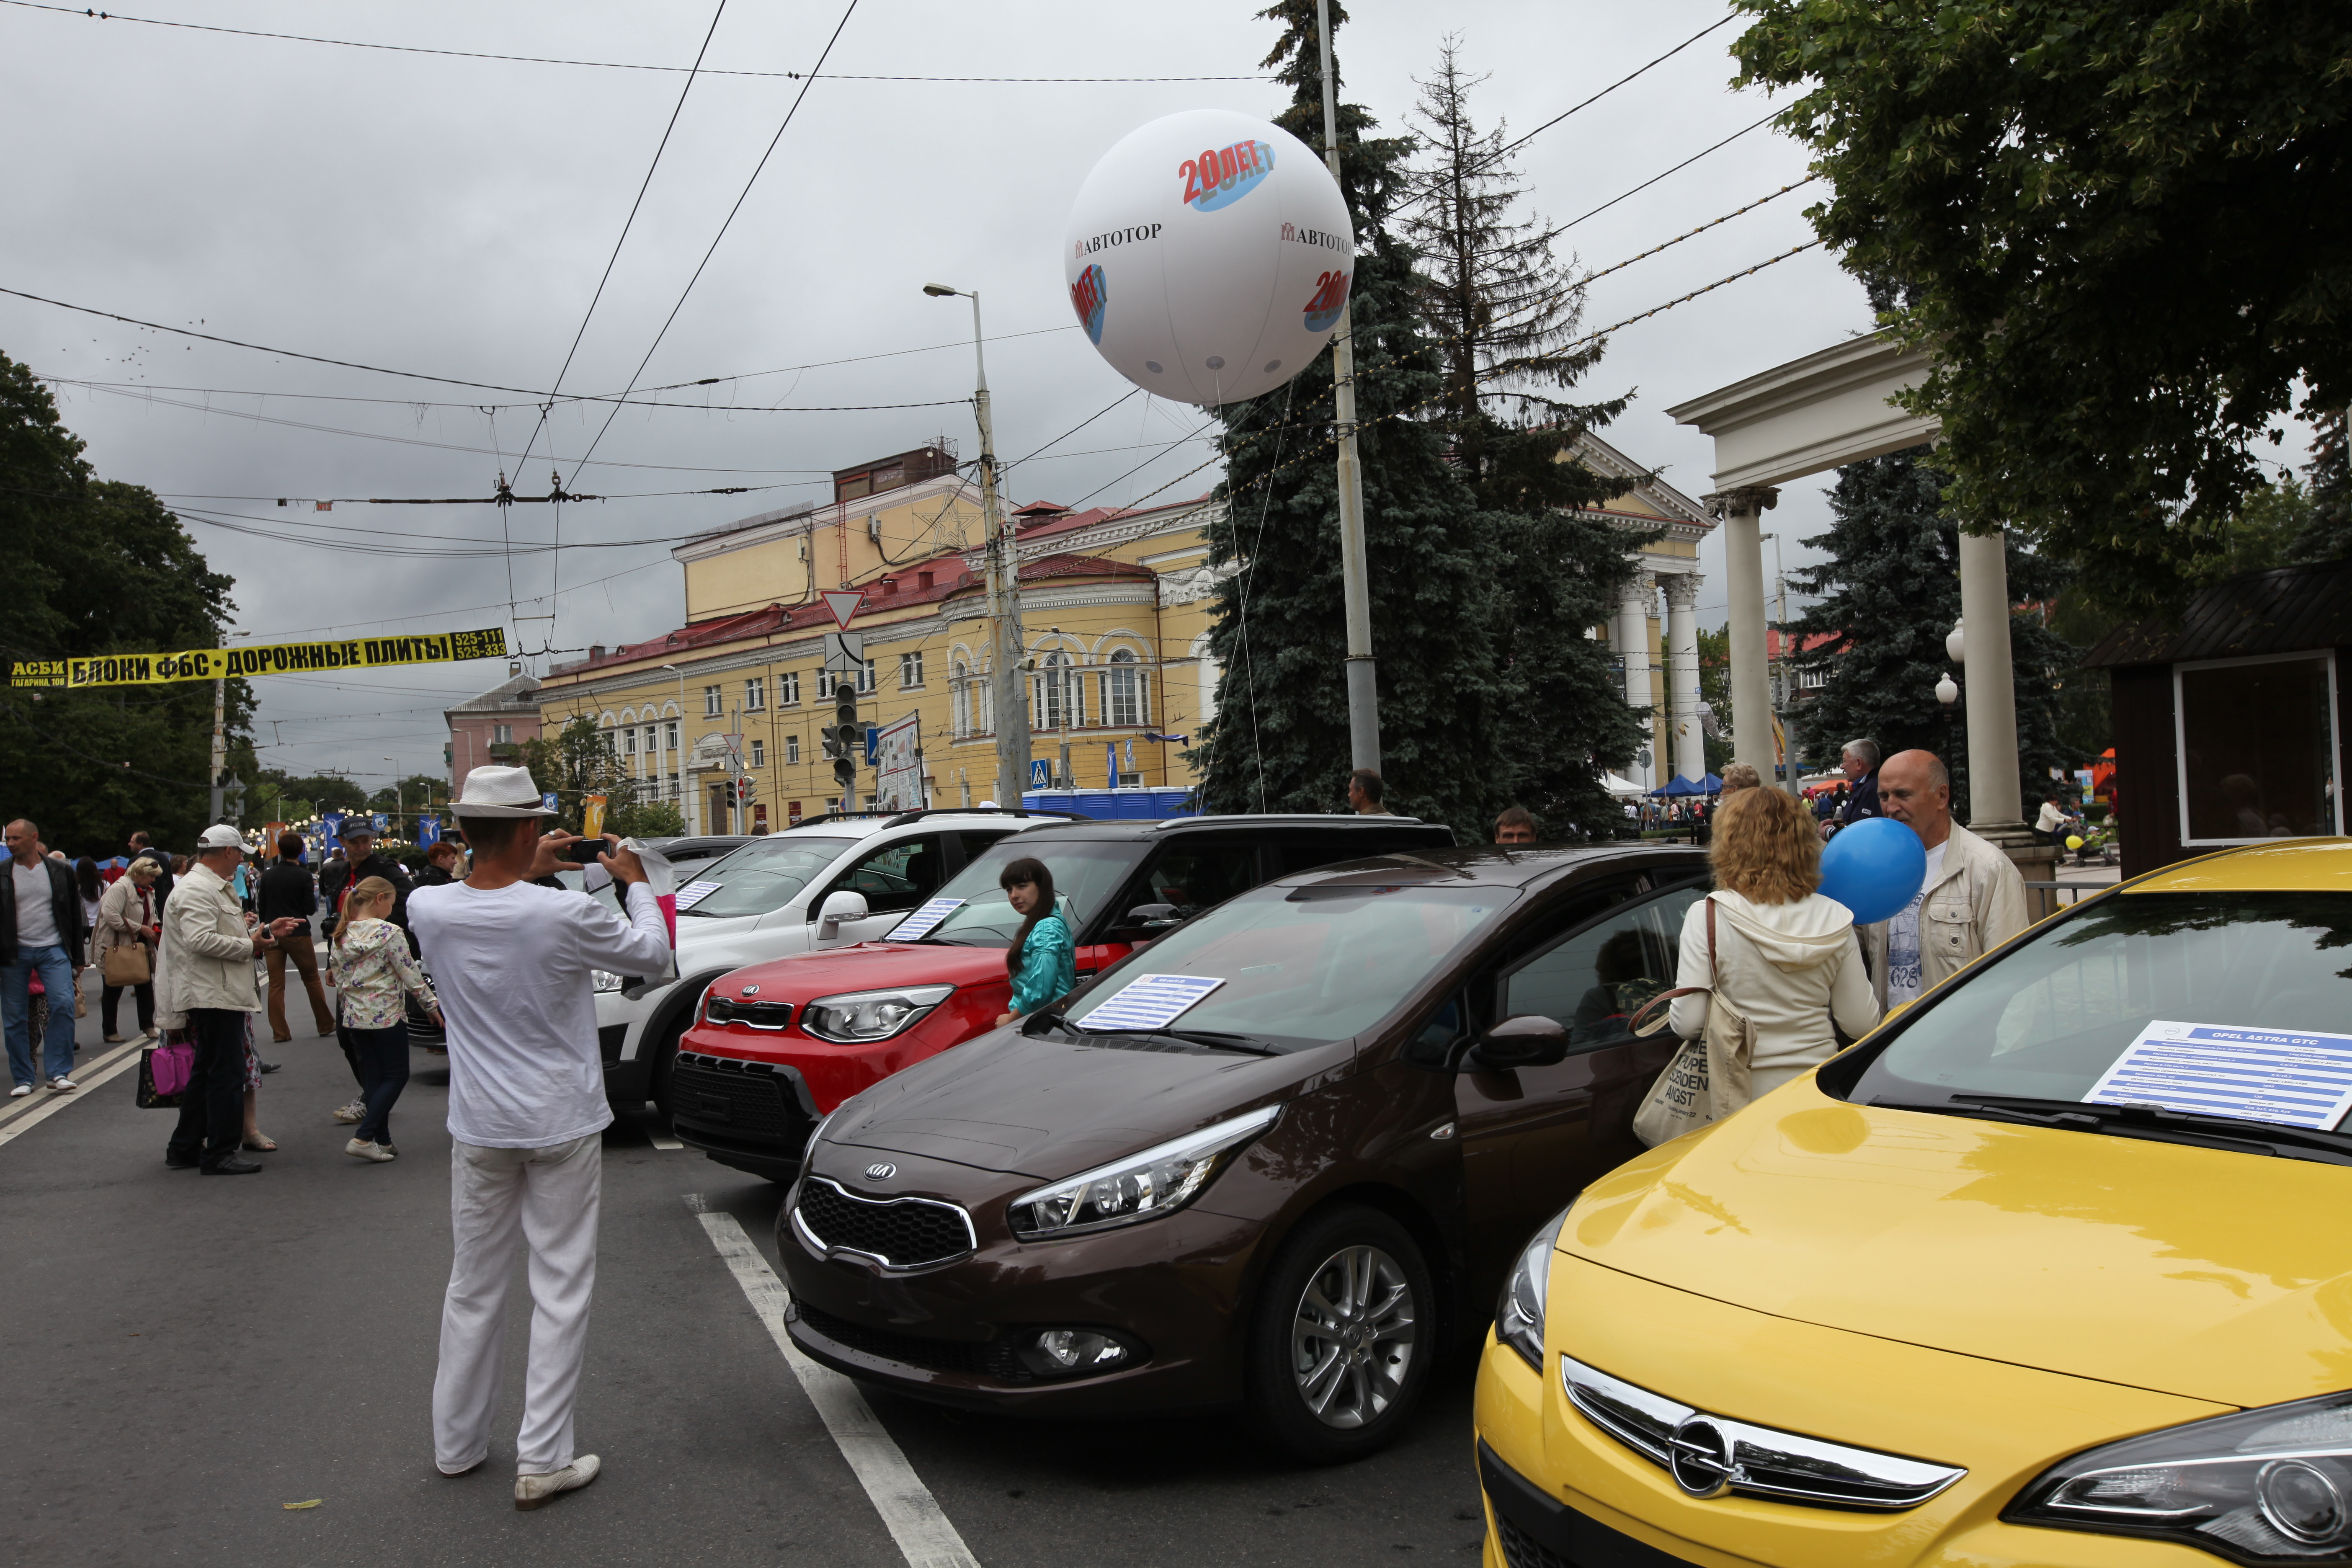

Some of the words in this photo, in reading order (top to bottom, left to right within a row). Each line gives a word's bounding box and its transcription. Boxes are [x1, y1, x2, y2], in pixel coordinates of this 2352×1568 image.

[1084, 223, 1161, 255] АВТОТОР
[1296, 228, 1351, 256] АВТОТОР
[455, 629, 503, 646] 525-111
[457, 642, 507, 659] 525-333
[11, 661, 64, 675] АСБИ
[72, 658, 150, 685] БЛОКИ
[156, 653, 209, 679] ФБС
[226, 642, 361, 677] ДОРОЖНЫЕ
[364, 637, 449, 664] ПЛИТЫ
[11, 678, 50, 687] ГАГАРИНА,
[1665, 1085, 1696, 1106] ANGST
[866, 1163, 890, 1177] KIA
